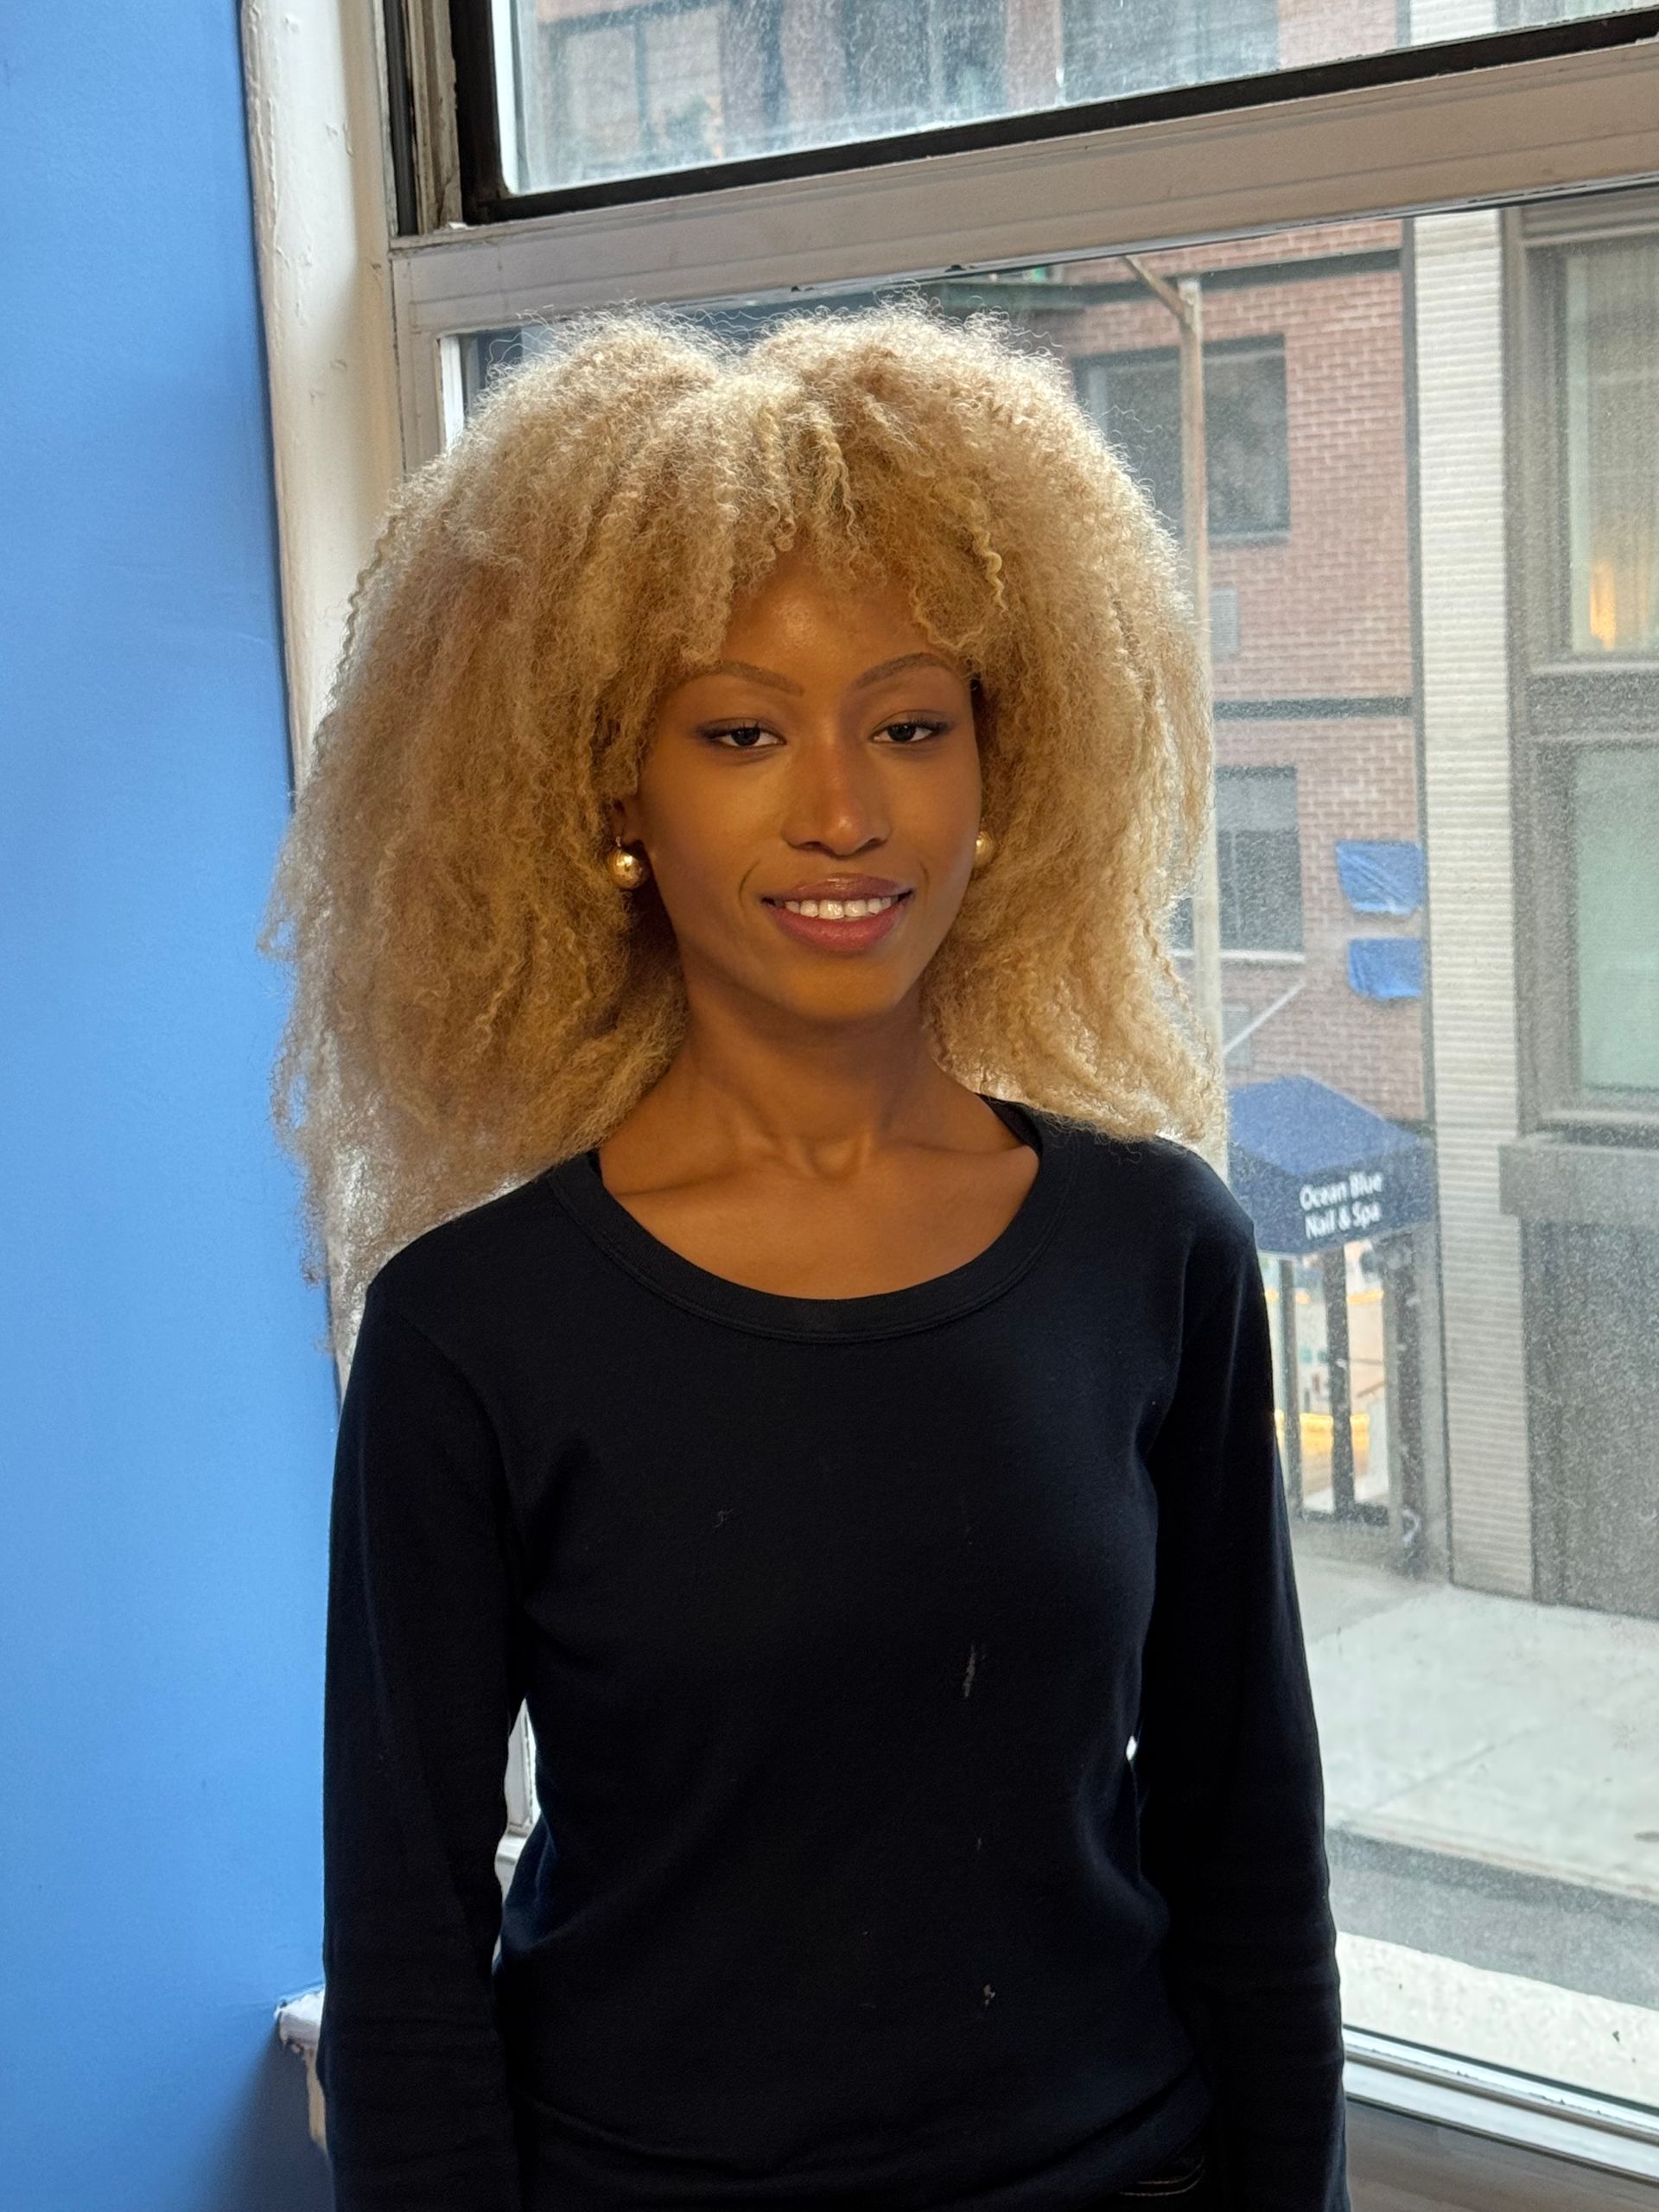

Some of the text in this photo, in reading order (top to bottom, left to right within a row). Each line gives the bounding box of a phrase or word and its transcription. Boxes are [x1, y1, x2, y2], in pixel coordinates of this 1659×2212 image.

[1299, 1171, 1383, 1211] Ocean Blue
[1305, 1201, 1381, 1240] Nail & Spa
